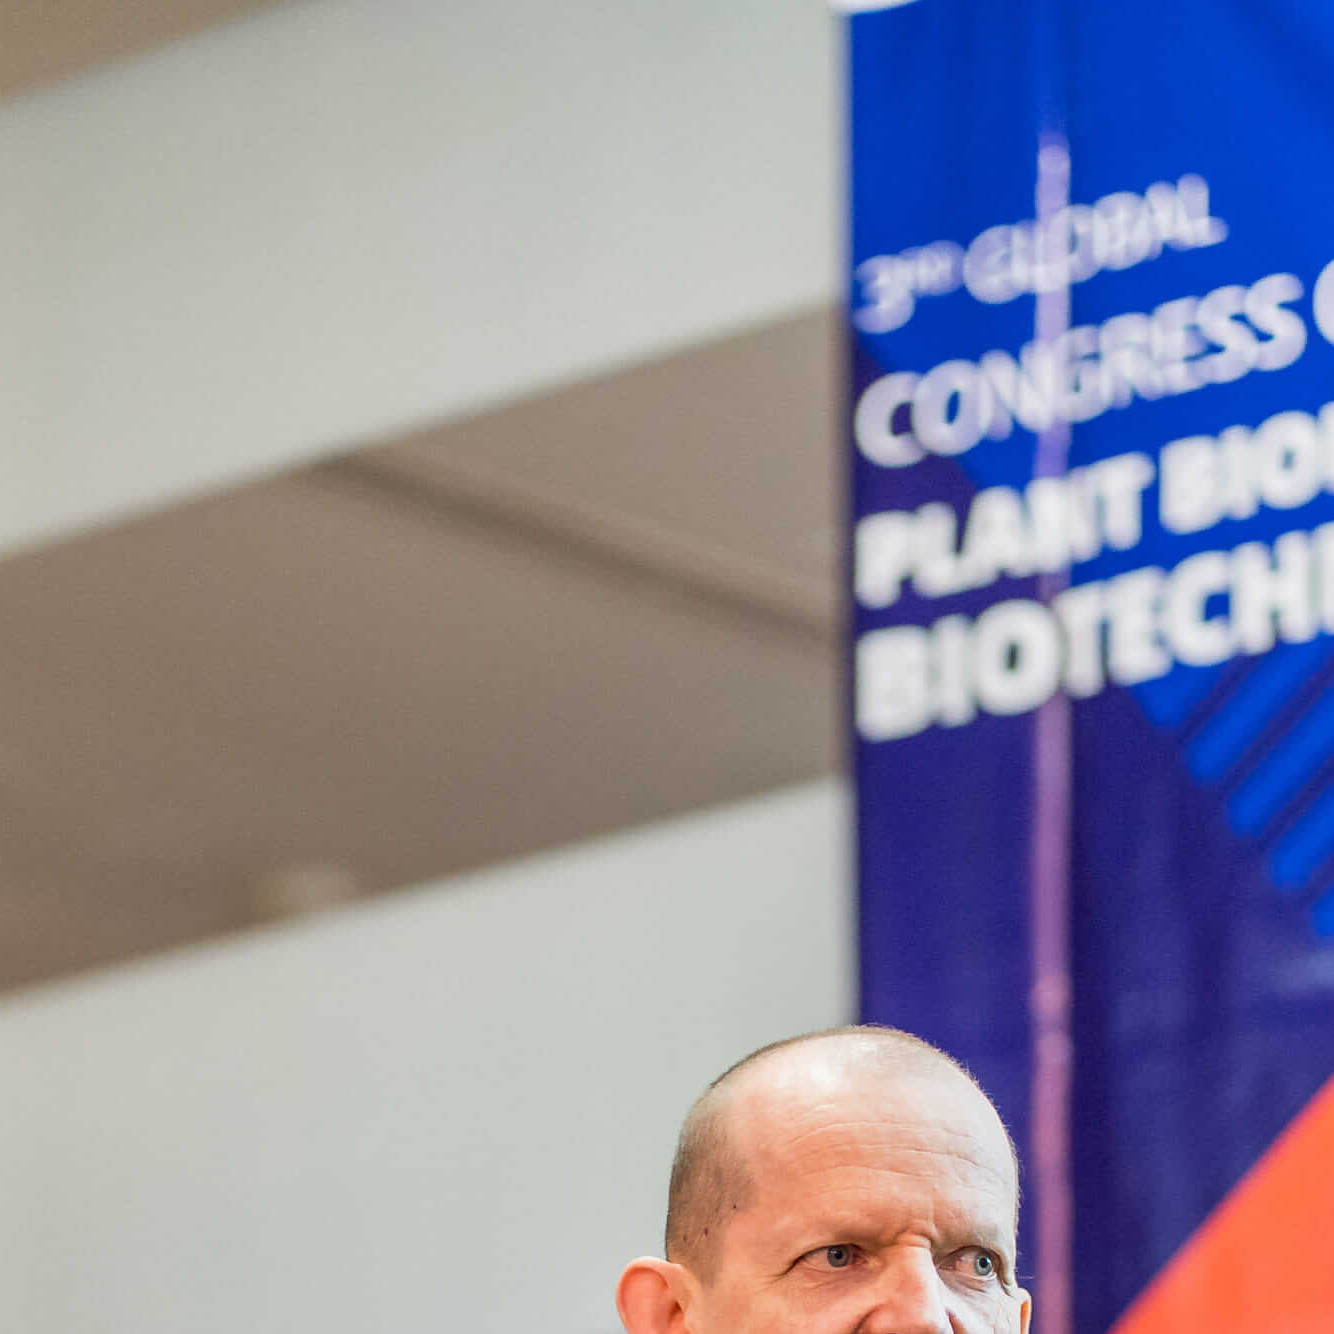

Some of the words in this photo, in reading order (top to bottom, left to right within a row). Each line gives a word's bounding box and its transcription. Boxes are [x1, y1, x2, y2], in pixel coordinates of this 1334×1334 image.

[964, 173, 1229, 304] GLOBAL
[853, 271, 1308, 467] CONGRESS
[854, 450, 1154, 608] PLANT
